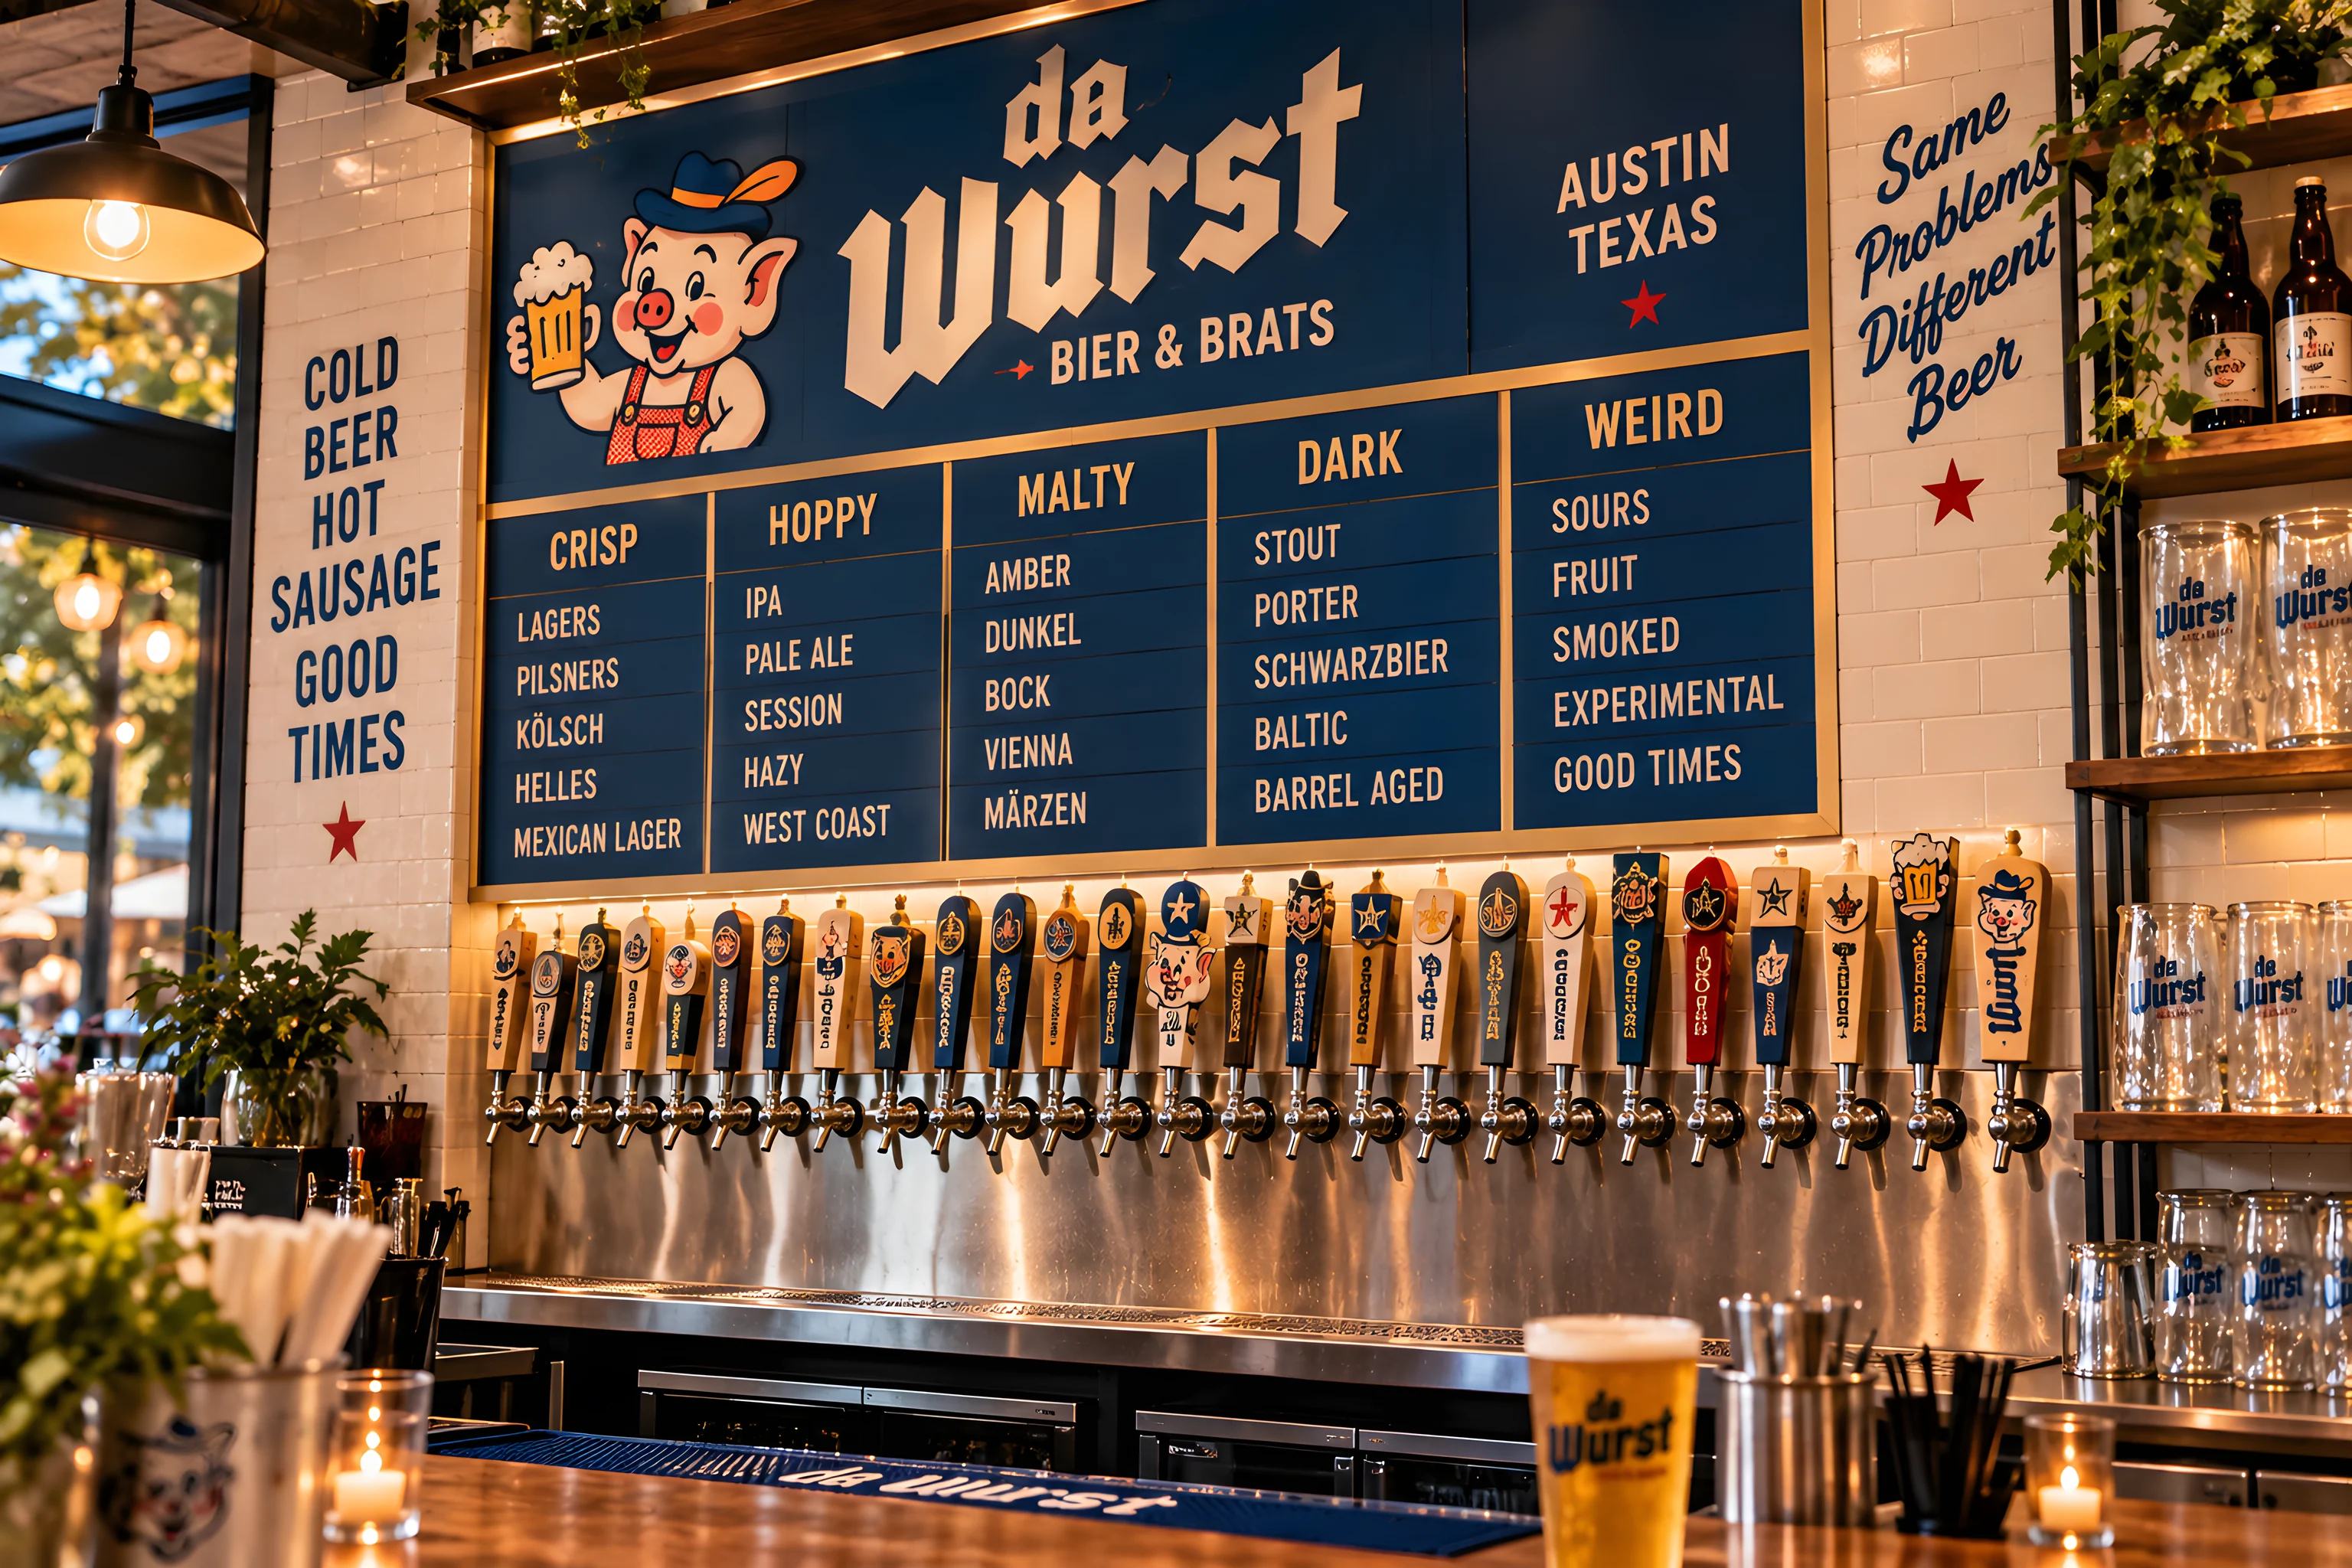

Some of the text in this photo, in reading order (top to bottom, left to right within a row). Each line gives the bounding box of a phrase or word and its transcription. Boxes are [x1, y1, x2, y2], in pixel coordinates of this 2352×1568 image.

[1004, 44, 1129, 168] da
[1557, 123, 1729, 214] AUSTIN
[1877, 92, 2010, 204] Same
[838, 47, 1363, 410] Wurst
[1569, 195, 1717, 274] TEXAS
[1855, 143, 2053, 300] Problems
[1858, 211, 2056, 377] Different
[1051, 299, 1334, 384] BIER & BRATS
[305, 336, 398, 411] COLD
[1906, 336, 2022, 443] Beer
[1585, 389, 1723, 449] WEIRD
[305, 405, 397, 481] BEER
[1299, 430, 1403, 485] DARK
[1019, 462, 1135, 517] MALTY
[1553, 489, 1649, 533] SOURS
[312, 479, 385, 550] HOT
[770, 493, 877, 545] HOPPY
[550, 524, 637, 570] CRISP
[1256, 524, 1341, 565] STOUT
[271, 540, 441, 633] SAUSAGE
[985, 554, 1070, 593] AMBER
[1554, 555, 1637, 597] FRUIT
[518, 605, 599, 642] LAGERS
[747, 585, 782, 619] IPA
[1256, 585, 1357, 627] PORTER
[2155, 592, 2237, 640] Wurst
[746, 634, 853, 675] PALE ALE
[986, 612, 1081, 652] DUNKEL
[1553, 617, 1679, 662] SMOKED
[296, 635, 397, 707] GOOD
[518, 658, 618, 696] PILSNERS
[1255, 639, 1448, 688] SCHWARZBIER
[745, 693, 841, 731] SESSION
[986, 675, 1050, 711] BOCK
[1555, 675, 1783, 727] EXPERIMENTAL
[289, 710, 404, 782] TIMES
[518, 712, 603, 749] KÖLSCH
[985, 733, 1073, 770] VIENNA
[1256, 710, 1347, 750] BALTIC
[516, 769, 596, 803] HELLES
[745, 753, 803, 788] HAZY
[1256, 767, 1442, 812] BARREL AGED
[1555, 744, 1741, 792] GOOD TIMES
[744, 805, 890, 844] WEST COAST
[985, 789, 1086, 829] MÄRZEN
[514, 818, 681, 858] MEXICAN LAGER
[2131, 971, 2206, 1015] Wurst
[2234, 971, 2303, 1013] Wurst
[1548, 1406, 1674, 1475] Wurst
